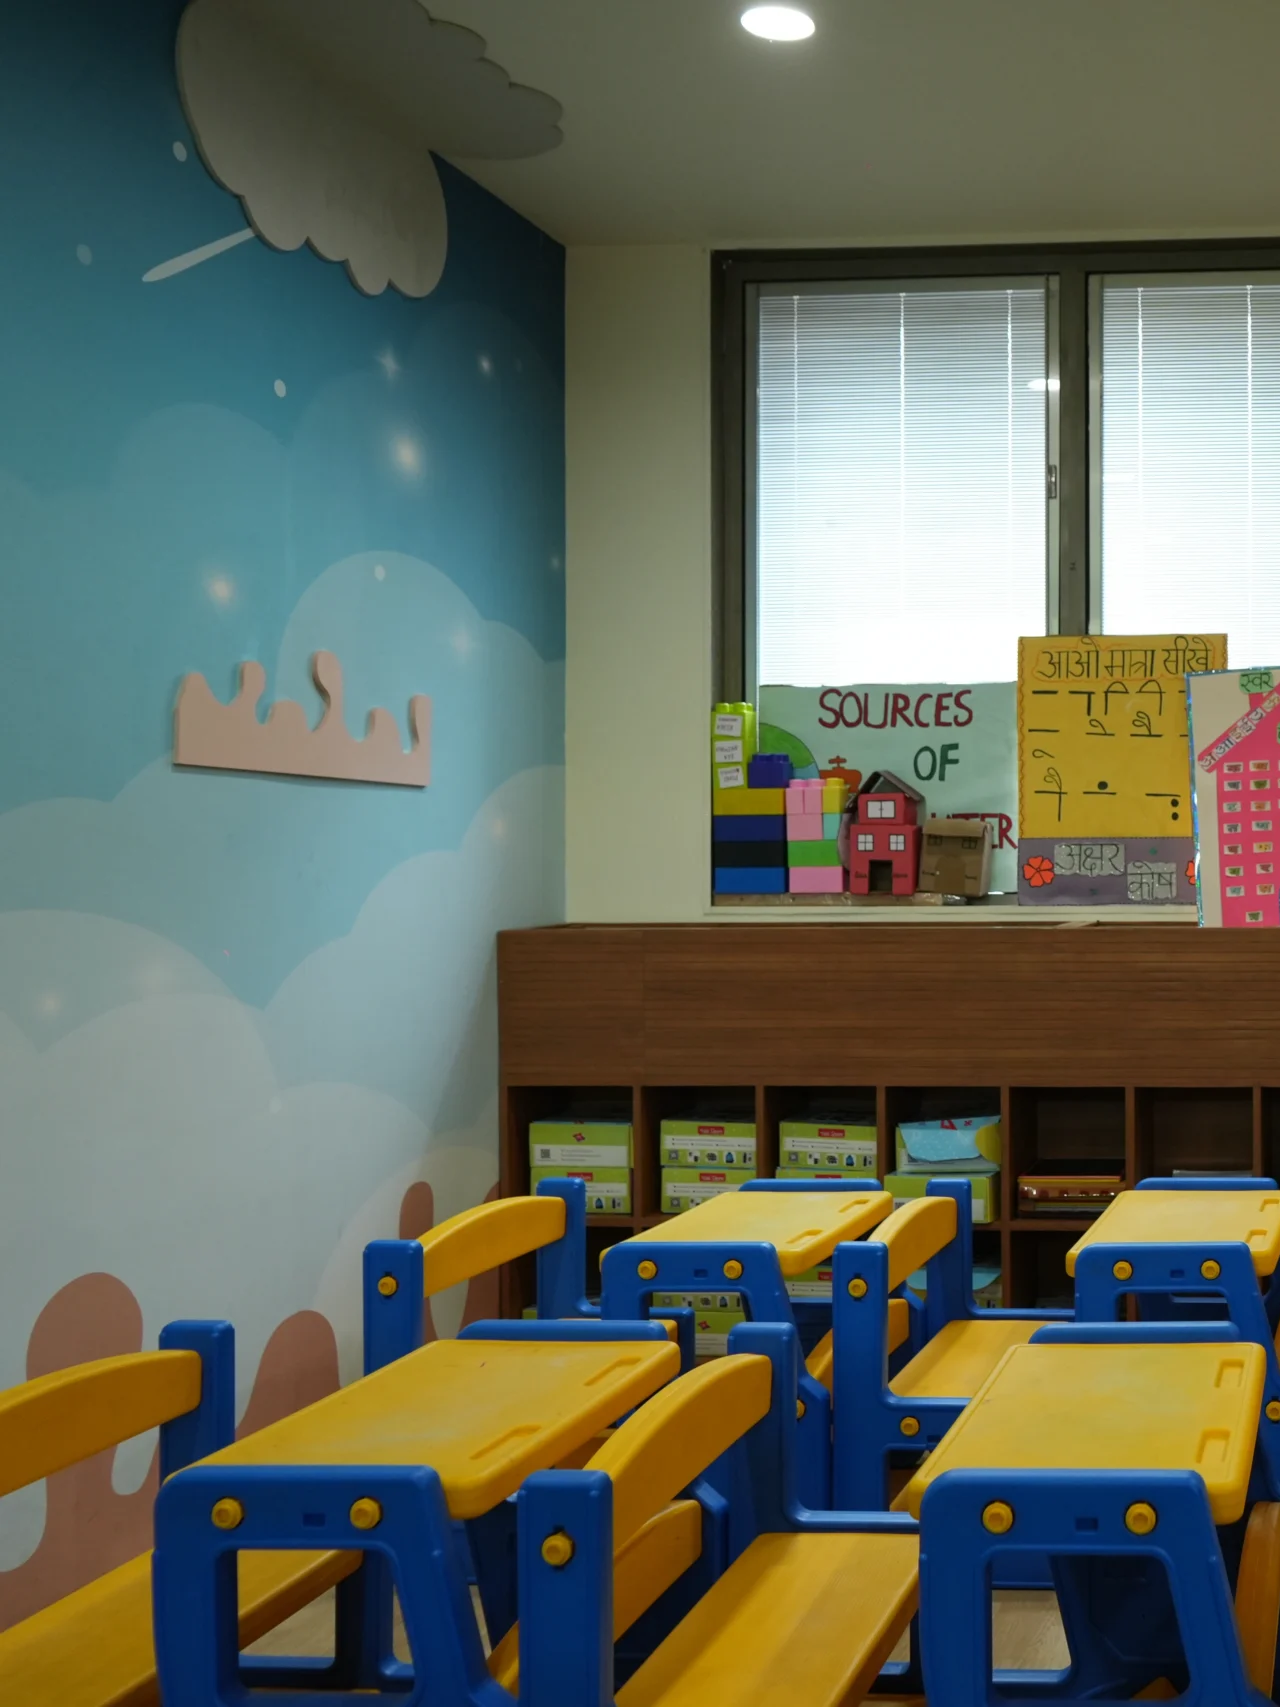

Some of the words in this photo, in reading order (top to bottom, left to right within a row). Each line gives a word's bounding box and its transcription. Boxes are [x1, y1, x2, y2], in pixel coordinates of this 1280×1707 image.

[1037, 637, 1099, 679] आओ
[1240, 672, 1274, 691] स्वर
[818, 688, 973, 729] SOURCES
[913, 743, 960, 781] OF
[1055, 843, 1124, 877] अक्षर
